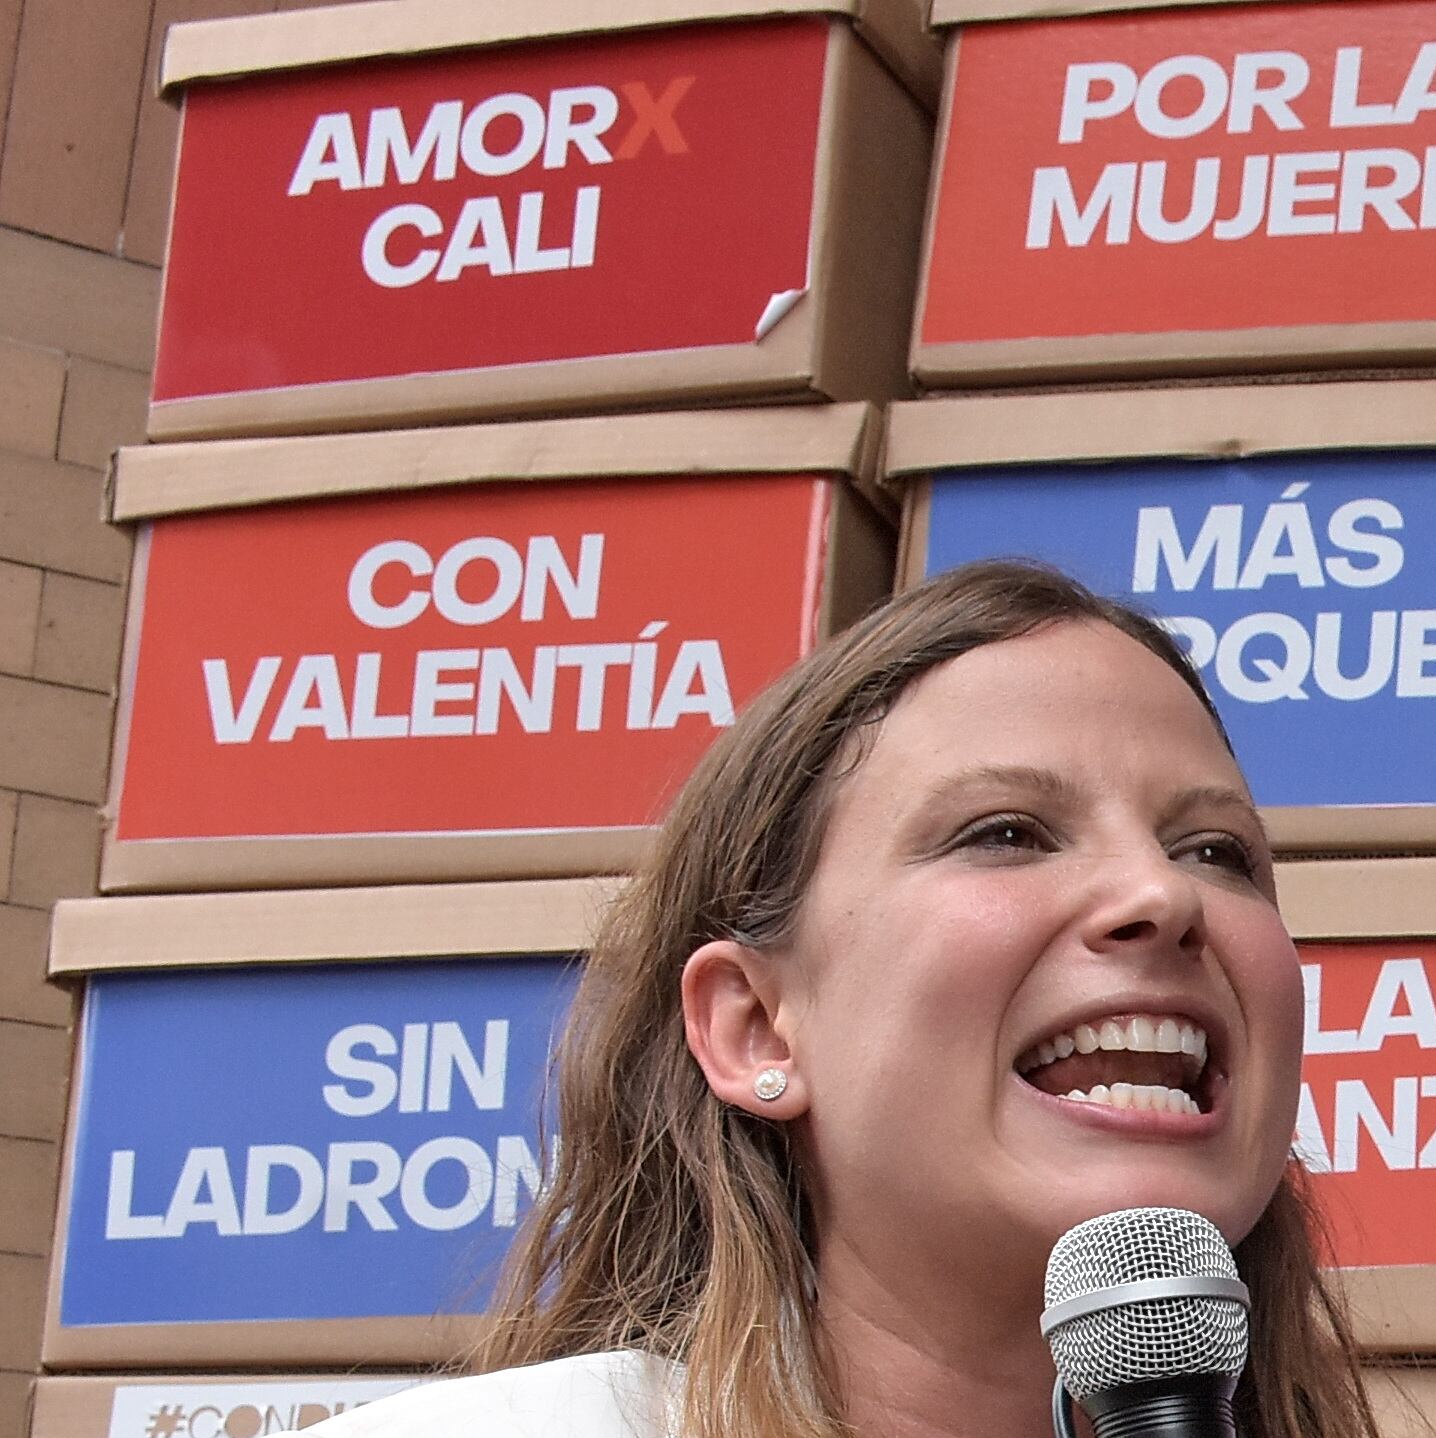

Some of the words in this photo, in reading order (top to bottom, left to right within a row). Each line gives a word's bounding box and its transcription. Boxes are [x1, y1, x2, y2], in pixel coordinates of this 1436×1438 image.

[1059, 52, 1309, 143] POR
[362, 186, 599, 287] CALI
[349, 535, 603, 627] CON
[1133, 483, 1403, 592] MÁS
[205, 622, 736, 742] VALENTÍA
[324, 1020, 507, 1115] SIN
[104, 1135, 562, 1240] LADRON
